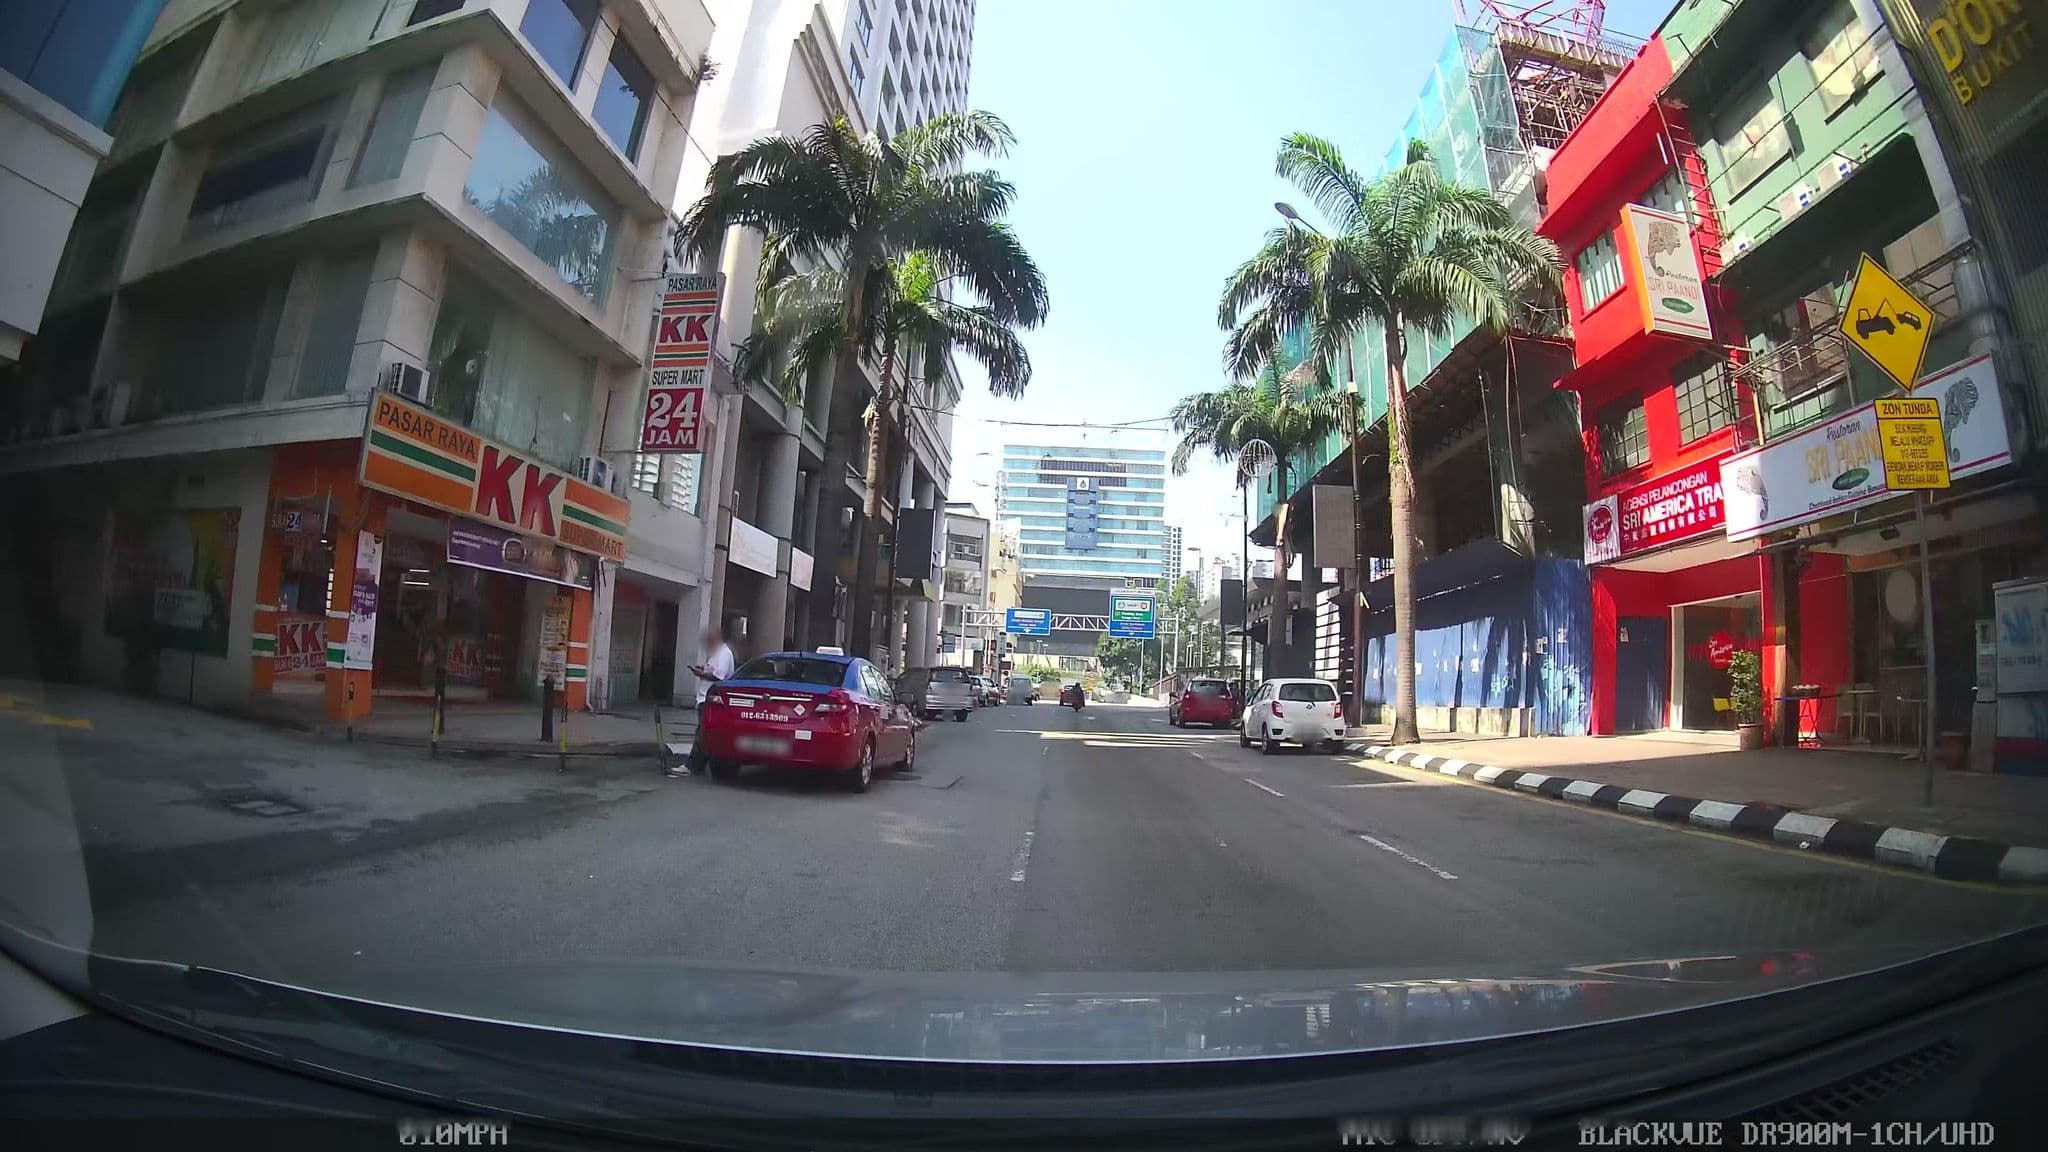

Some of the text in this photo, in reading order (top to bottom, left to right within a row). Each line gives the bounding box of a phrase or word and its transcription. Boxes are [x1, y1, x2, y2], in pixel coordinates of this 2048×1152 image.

[667, 276, 717, 292] PASAR RAYA
[1648, 277, 1665, 294] SRI
[660, 315, 712, 343] KK
[652, 369, 704, 386] SUPER MART
[647, 391, 697, 429] 24
[1882, 403, 1933, 415] ZON TUNDA
[378, 400, 476, 459] PASAR RAYA
[645, 430, 694, 445] JAM
[1826, 420, 1862, 442] Restoran
[1807, 445, 1831, 484] SRI
[475, 445, 564, 537] KK
[1623, 471, 1708, 512] AGENSI PELANCONGAN
[1623, 510, 1641, 531] SRI
[1642, 493, 1695, 526] AMERICA
[280, 622, 321, 656] KK
